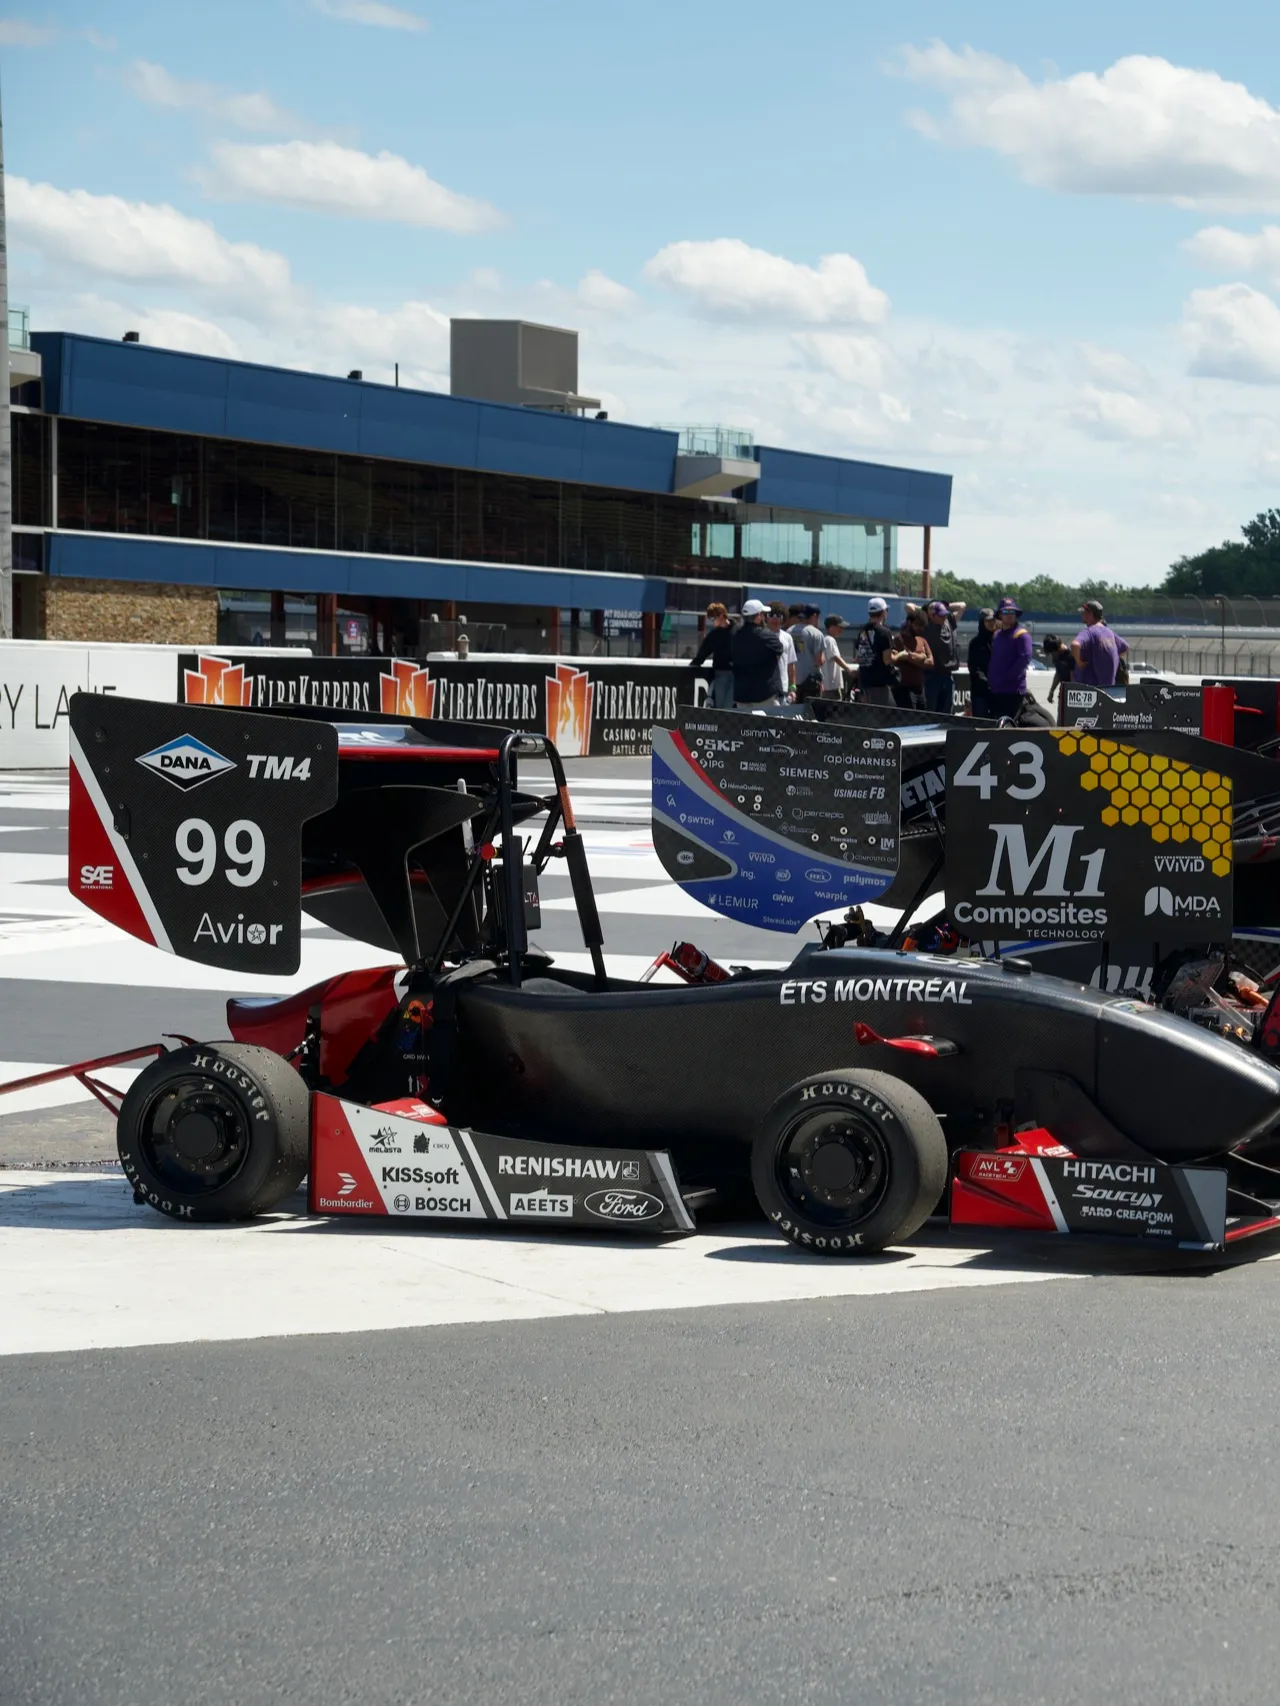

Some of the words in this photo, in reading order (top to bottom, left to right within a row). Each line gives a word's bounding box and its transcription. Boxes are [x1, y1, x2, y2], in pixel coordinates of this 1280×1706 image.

[1173, 690, 1200, 700] peripheral
[603, 728, 636, 741] CASINO
[612, 744, 635, 755] BATTLE
[703, 738, 745, 752] SKF
[160, 755, 212, 771] DANA
[246, 754, 312, 781] TM4
[708, 760, 725, 769] IPG
[953, 741, 1046, 800] 43
[779, 766, 830, 780] SIEMENS
[833, 788, 868, 799] USINAGE
[869, 787, 886, 800] FB
[687, 814, 715, 826] SWTCH
[175, 817, 266, 888] 99
[975, 823, 1106, 897] M1
[80, 865, 114, 885] SAE
[843, 874, 886, 887] polymos
[718, 896, 759, 910] LEMUR
[1174, 896, 1221, 912] MDA
[953, 901, 1108, 930] Composites
[1174, 911, 1222, 919] SPACE
[193, 912, 283, 945] Avior
[1026, 929, 1105, 939] TECHNOLOGY
[780, 979, 828, 1005] ÉTS
[834, 976, 973, 1005] MONTRÉAL
[498, 1155, 622, 1180] RENISHAW
[979, 1161, 1000, 1172] AVL
[1063, 1160, 1156, 1184] HITACHI
[382, 1166, 460, 1185] KISSsoft
[319, 1197, 373, 1209] Bombardier
[415, 1196, 471, 1212] BOSCH
[513, 1196, 569, 1213] AEETS
[599, 1192, 649, 1217] Ford
[1081, 1205, 1113, 1218] FARO
[1115, 1208, 1174, 1224] CREAFORM
